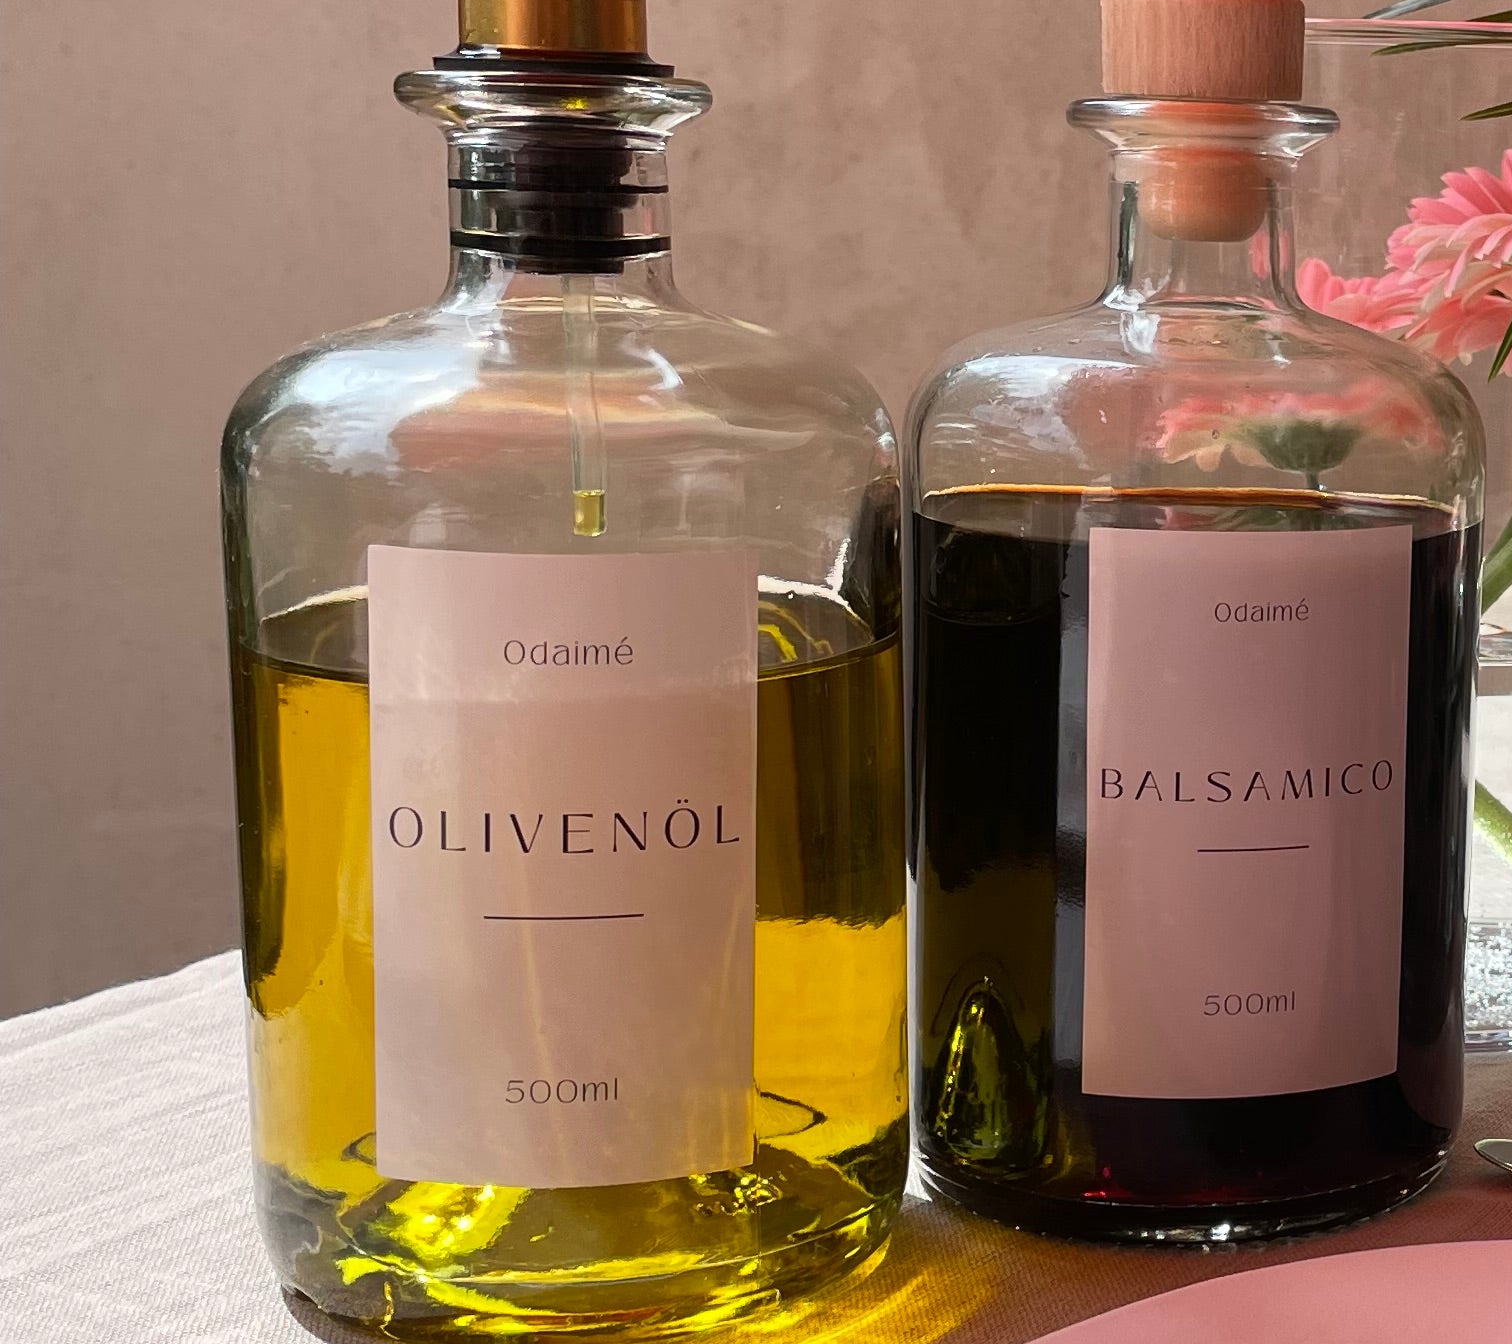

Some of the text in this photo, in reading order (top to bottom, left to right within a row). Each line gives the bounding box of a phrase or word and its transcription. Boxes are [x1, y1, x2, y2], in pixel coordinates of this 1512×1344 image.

[1213, 597, 1311, 624] Odaimé
[503, 636, 635, 666] Odaimé
[1100, 759, 1394, 804] BALSAMICO
[388, 798, 740, 854] OLIVENÖL
[1202, 990, 1297, 1017] 500ml
[504, 1077, 620, 1105] 500ml
